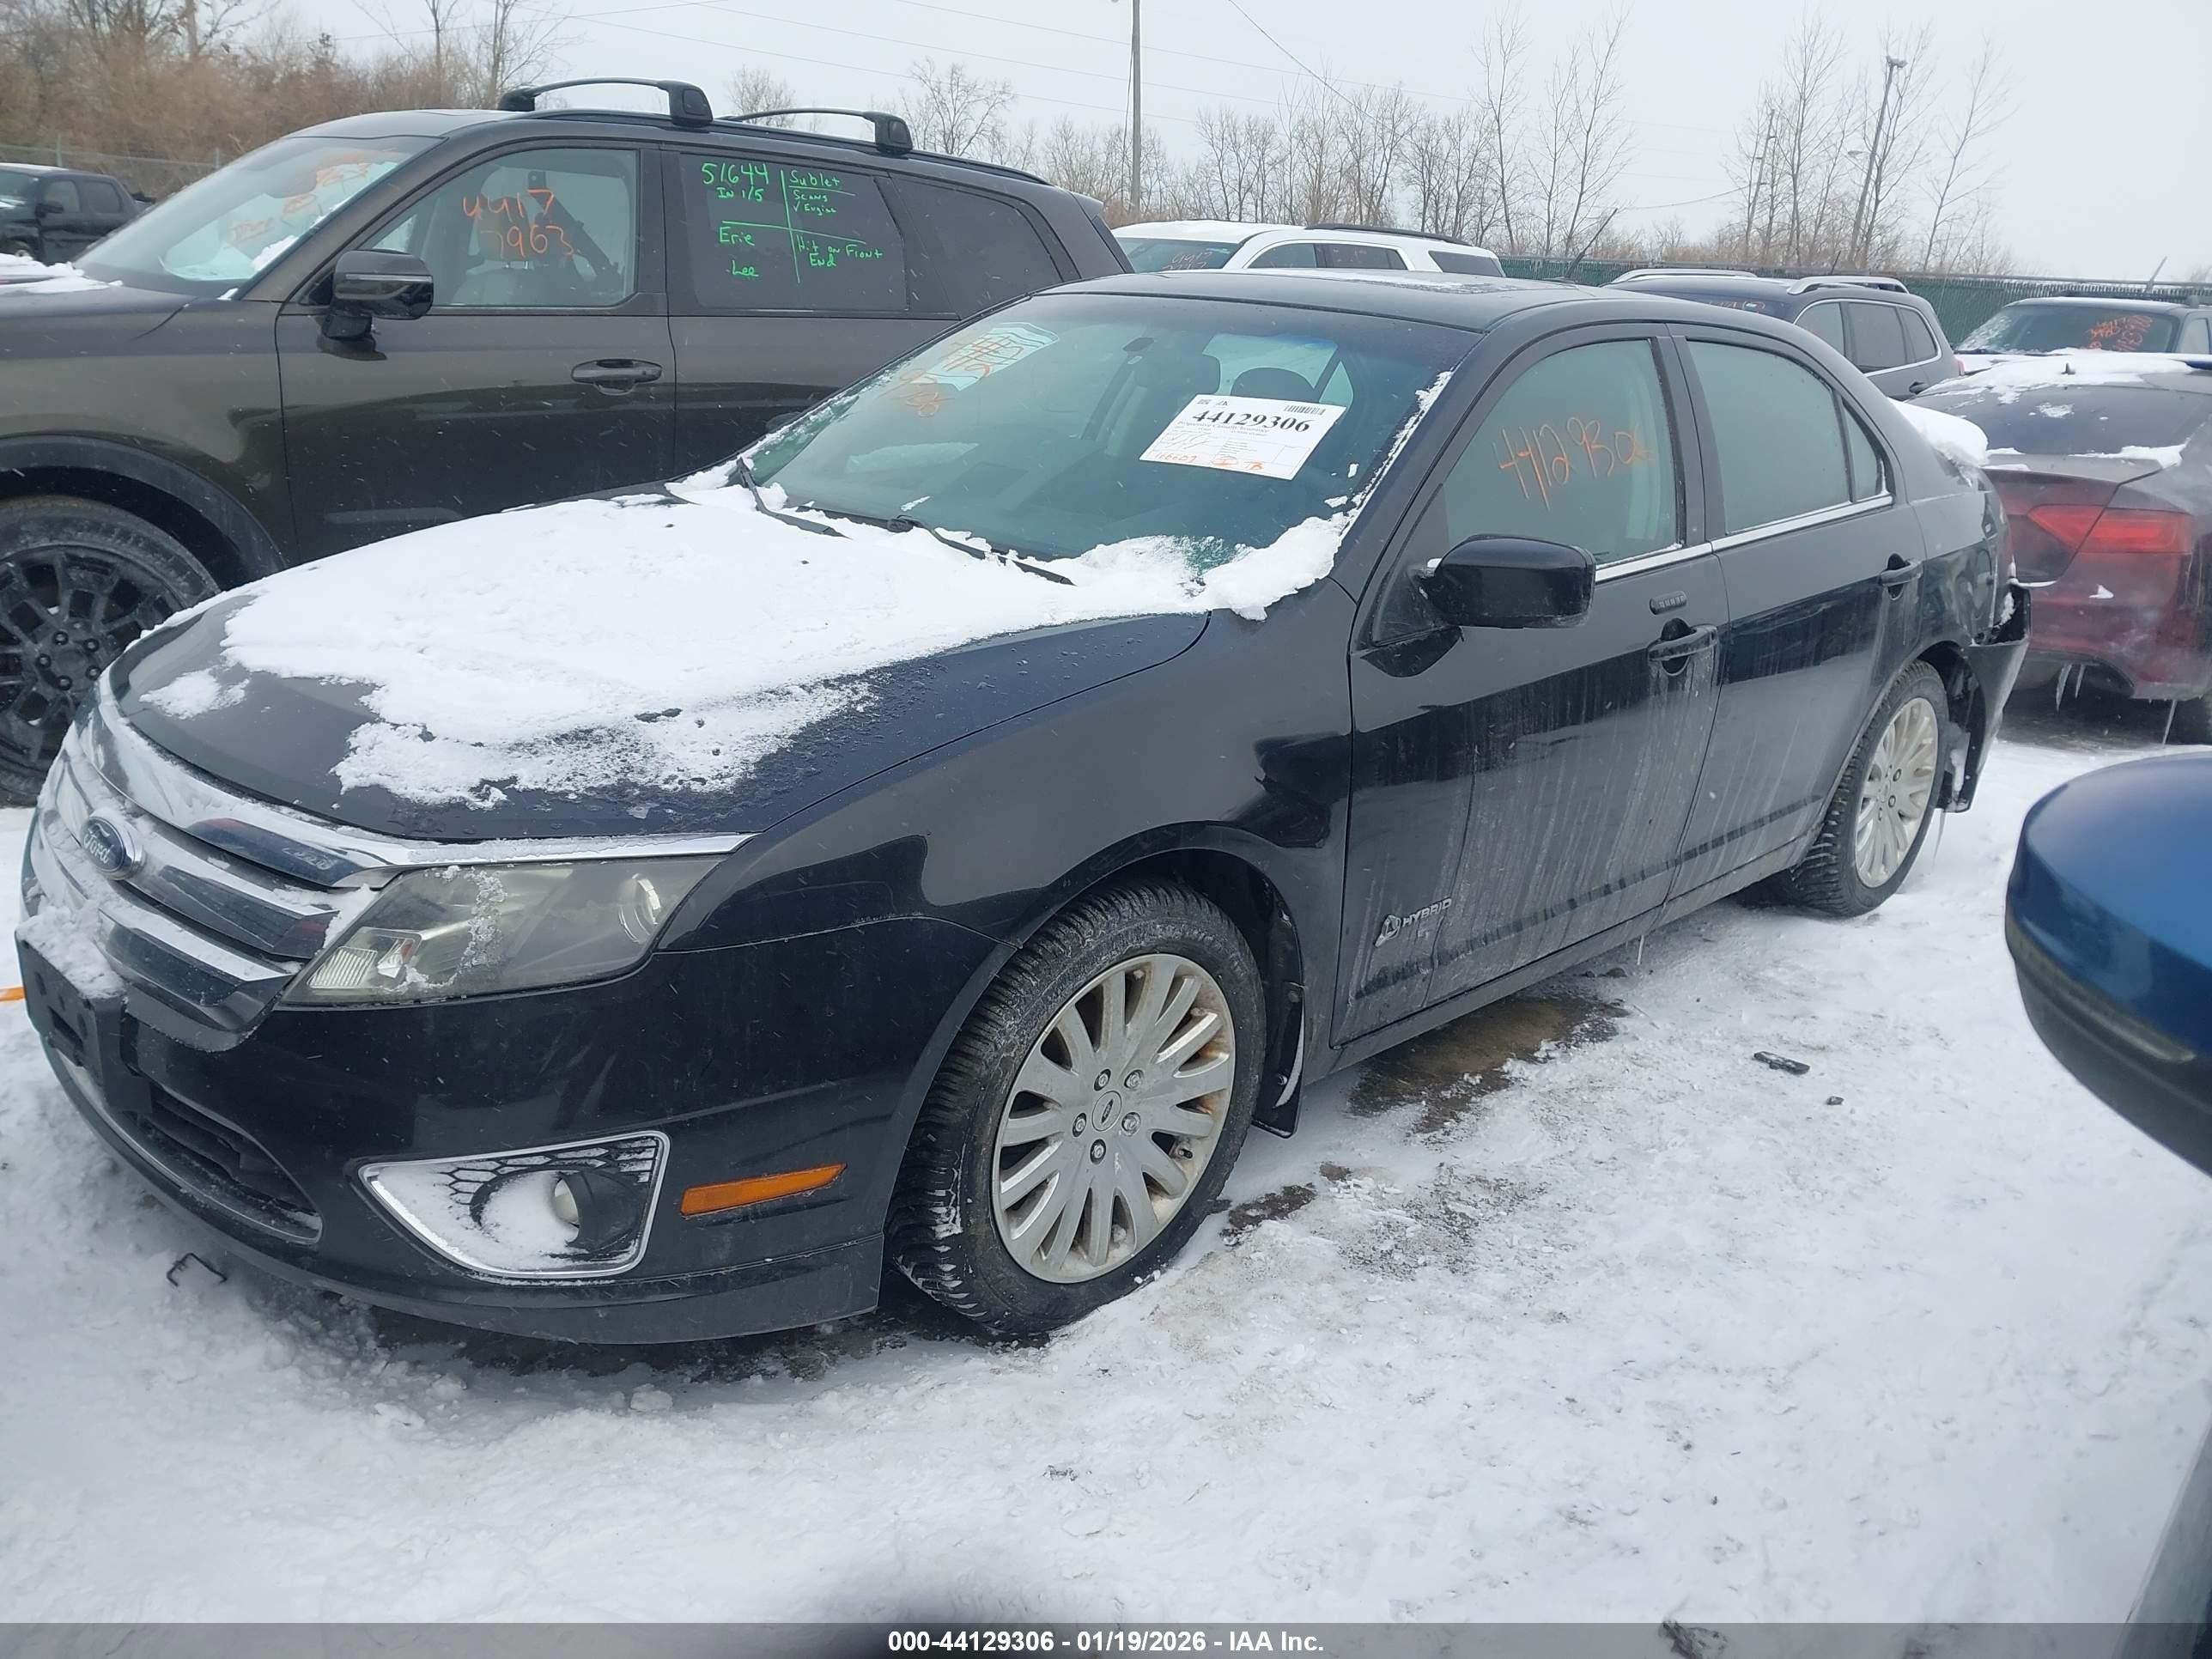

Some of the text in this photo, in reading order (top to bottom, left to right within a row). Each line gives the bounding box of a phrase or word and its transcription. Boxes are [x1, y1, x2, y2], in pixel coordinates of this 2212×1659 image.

[702, 162, 769, 185] 51644
[790, 169, 840, 187] Sublet
[741, 186, 765, 202] 1/5
[719, 226, 755, 246] Erie
[732, 260, 759, 277] Lee
[1192, 410, 1318, 433] 44129306
[83, 822, 115, 865] Ford
[1402, 897, 1452, 927] HYBRID
